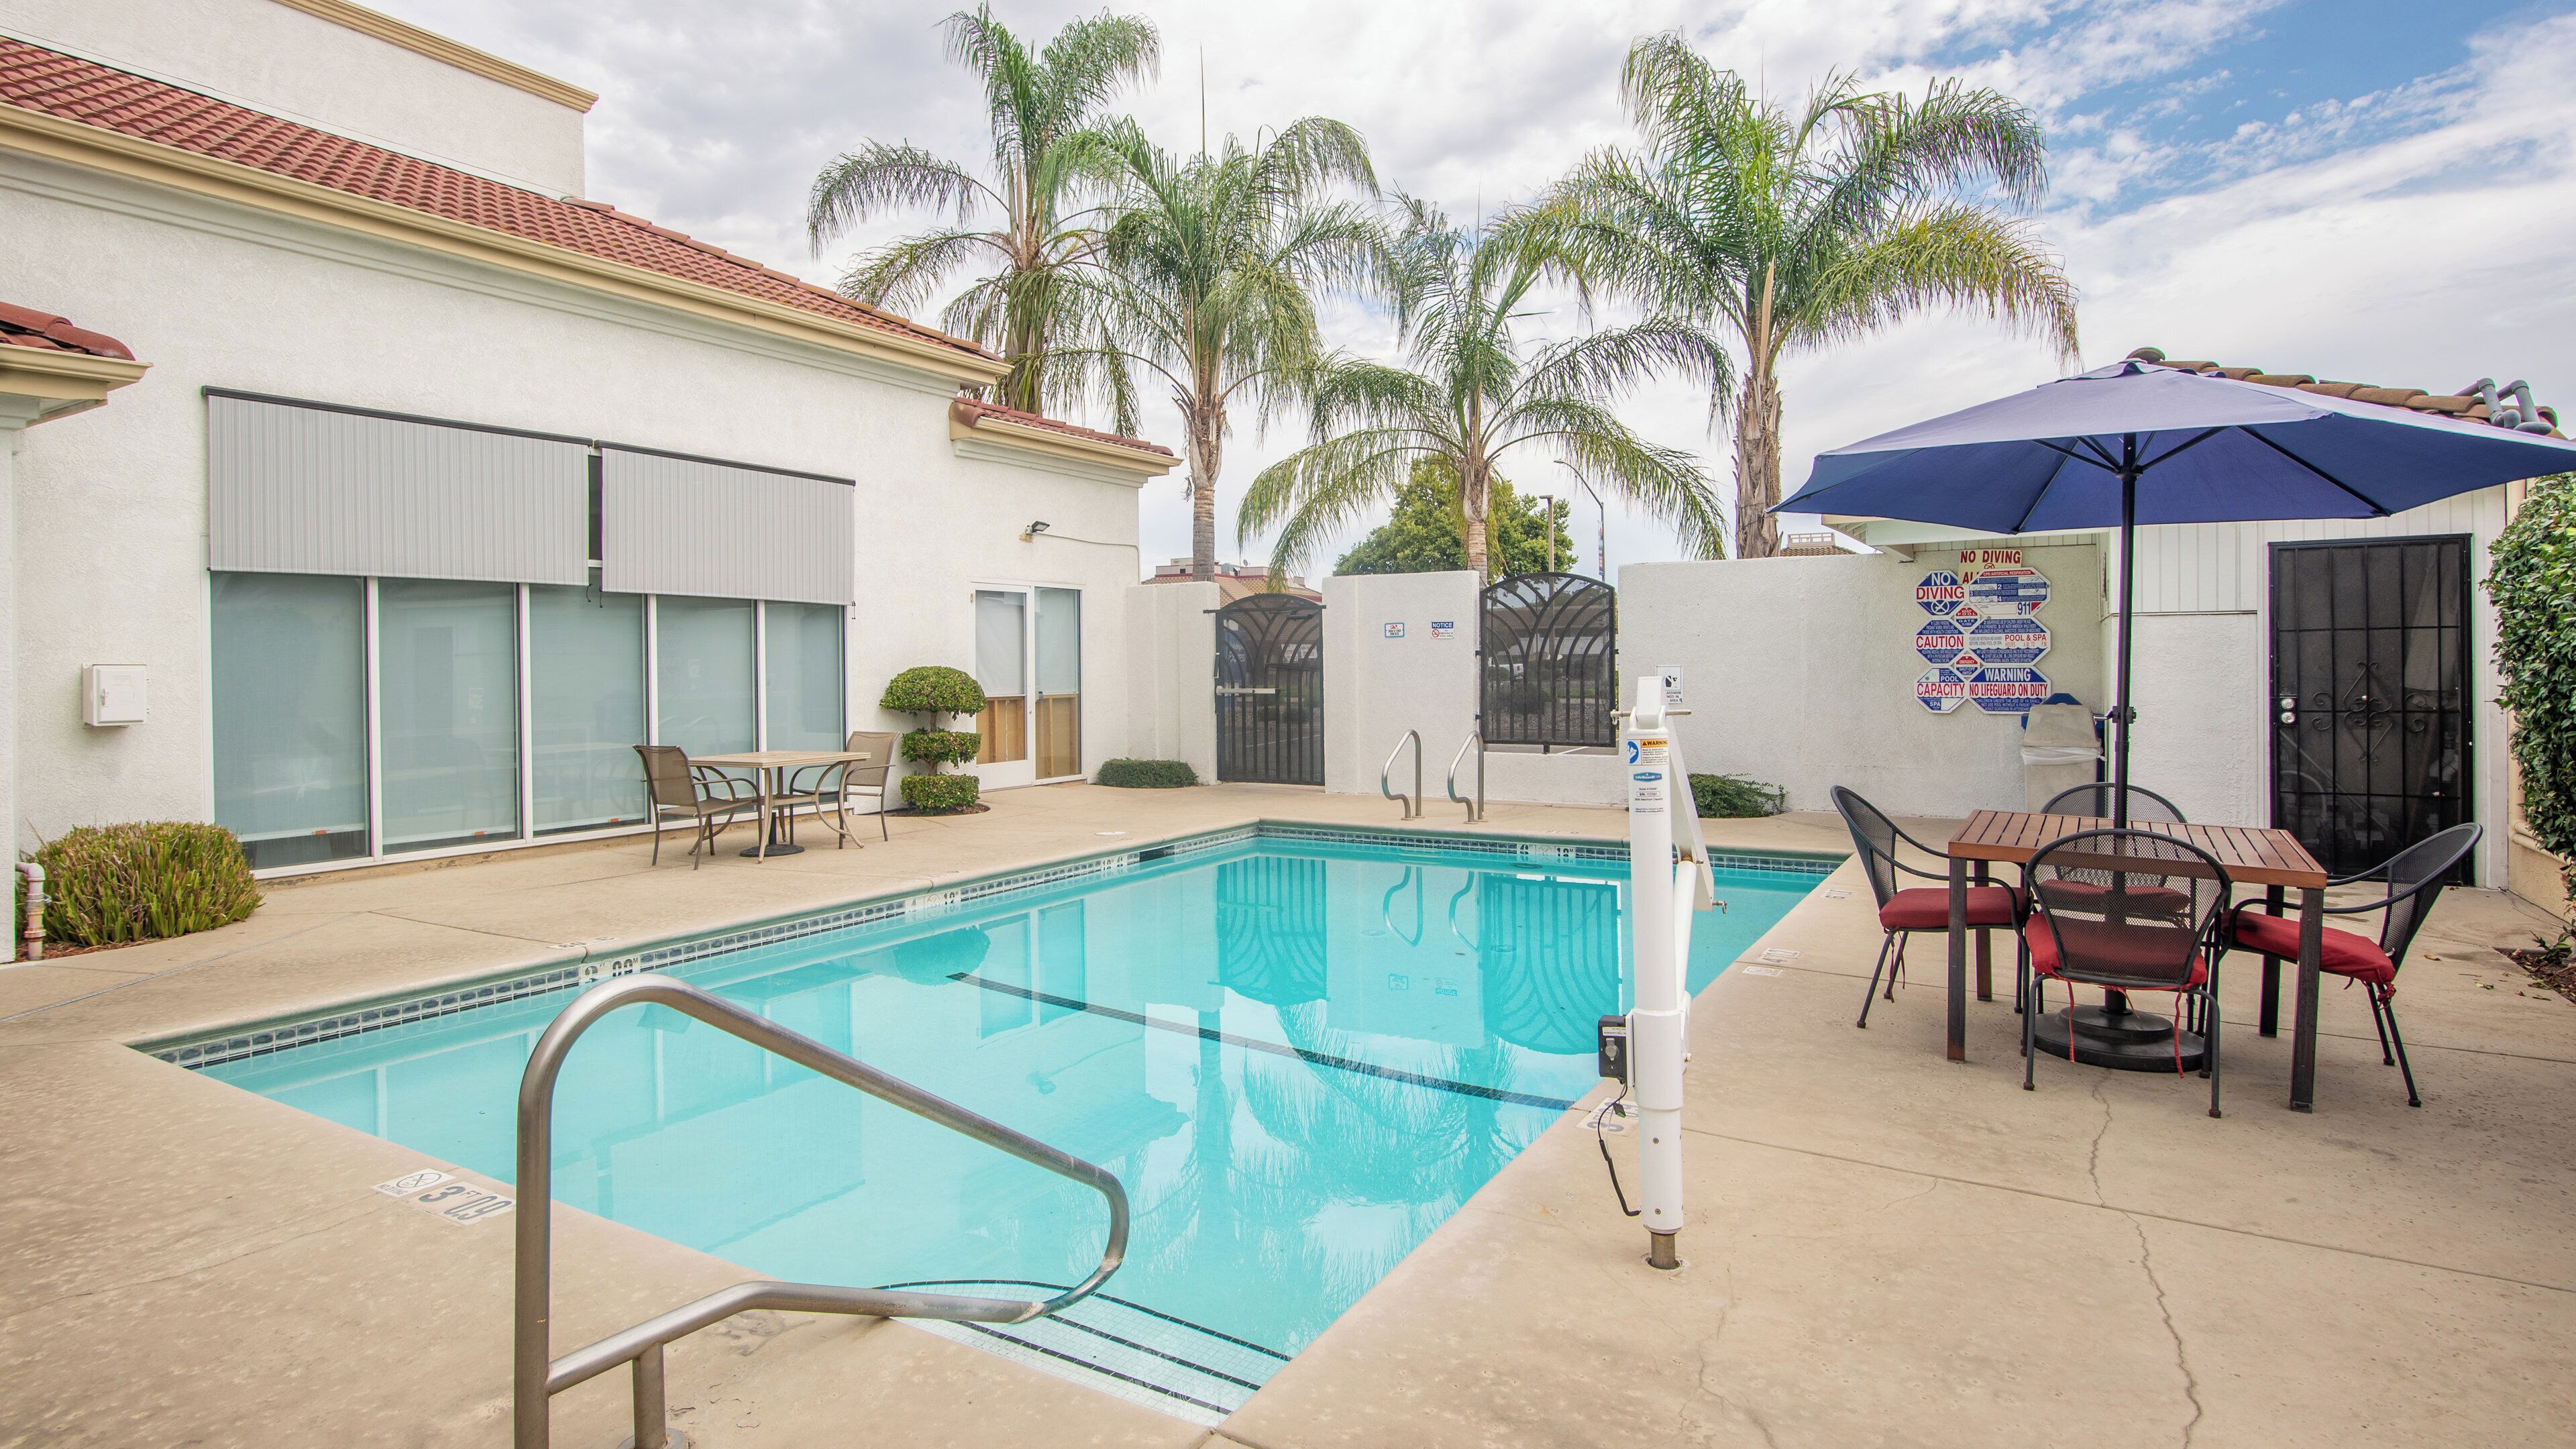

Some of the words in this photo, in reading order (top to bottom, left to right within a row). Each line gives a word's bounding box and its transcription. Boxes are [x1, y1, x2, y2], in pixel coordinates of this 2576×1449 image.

[1960, 550, 1976, 564] NO
[1982, 550, 2021, 564] DIVING
[1931, 572, 1951, 586] NO
[1916, 586, 1964, 600] DIVING
[2017, 602, 2031, 614] 911
[1916, 635, 1964, 648] CAUTION
[1984, 668, 2031, 682] WARNING
[1917, 683, 1965, 696] CAPACITY
[1969, 684, 1979, 696] NO
[1981, 684, 2017, 696] LIFEGUARD
[2018, 684, 2028, 696] ON
[2030, 684, 2048, 696] DUTY
[418, 1185, 466, 1203] 3
